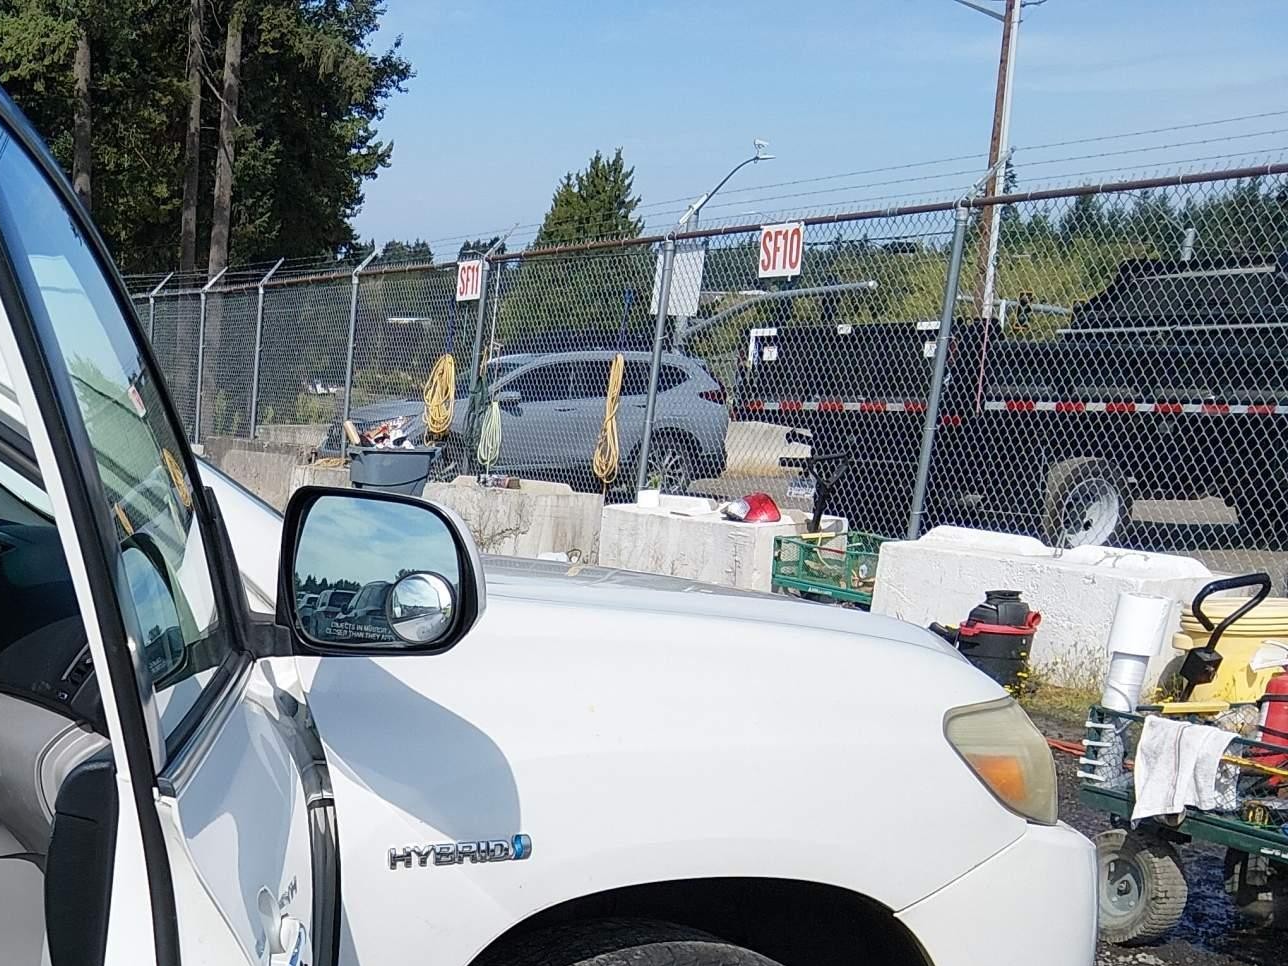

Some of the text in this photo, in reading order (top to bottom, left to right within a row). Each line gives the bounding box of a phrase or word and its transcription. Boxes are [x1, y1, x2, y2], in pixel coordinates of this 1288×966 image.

[761, 228, 801, 271] SF10
[459, 265, 479, 296] SF11
[349, 630, 364, 638] THAN
[365, 631, 381, 639] THEY
[356, 624, 363, 632] IN
[388, 839, 513, 871] HYBRID
